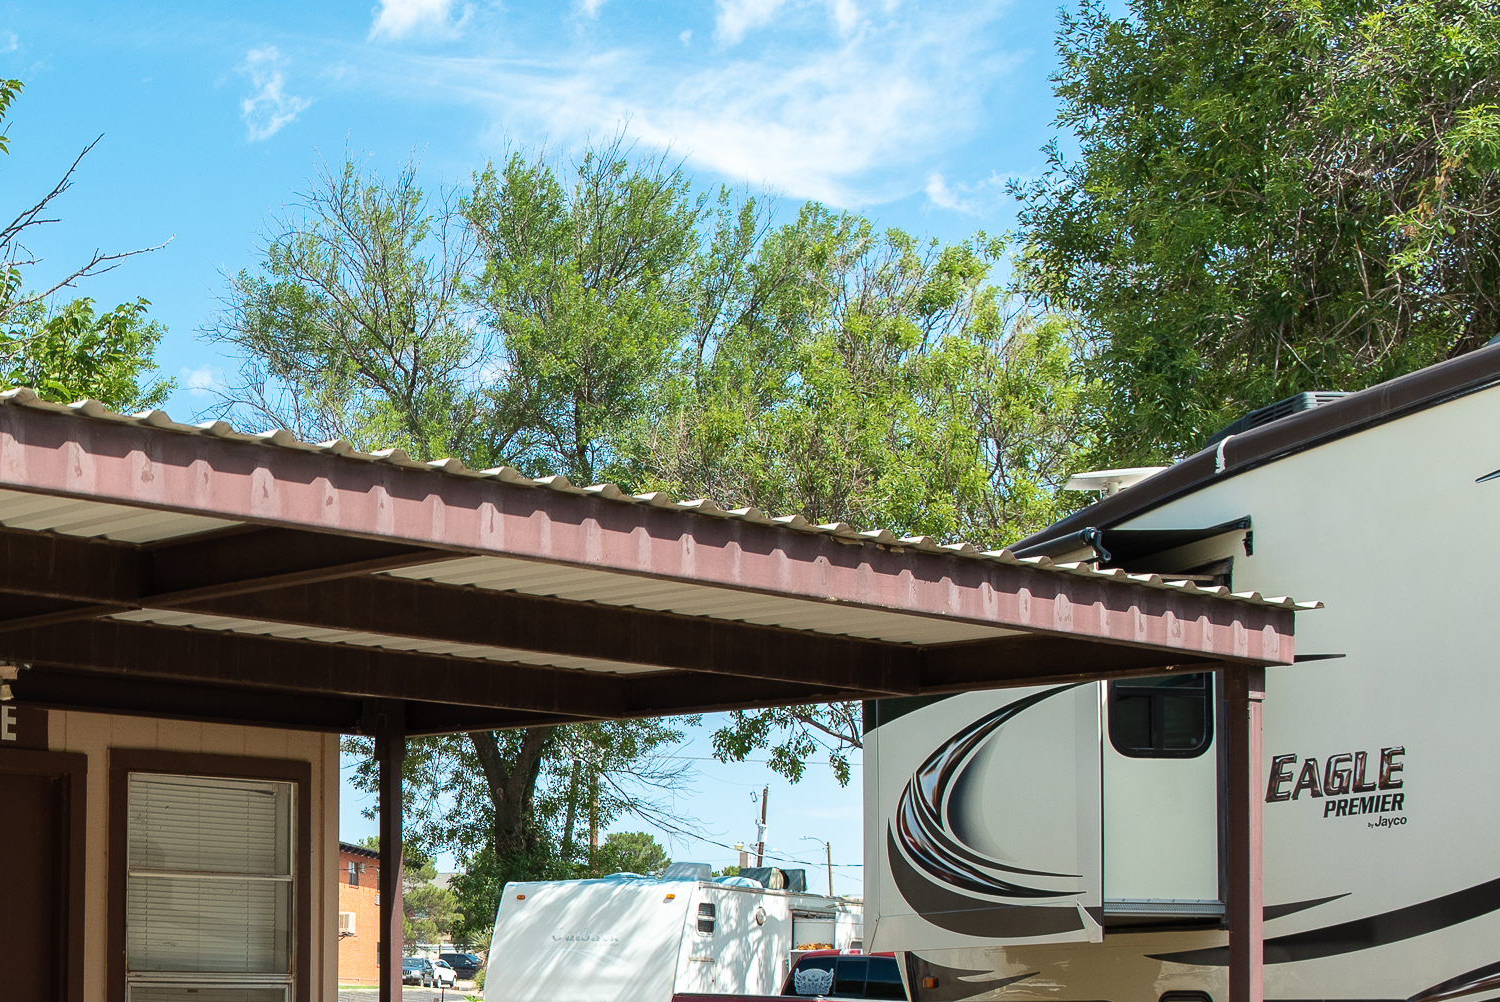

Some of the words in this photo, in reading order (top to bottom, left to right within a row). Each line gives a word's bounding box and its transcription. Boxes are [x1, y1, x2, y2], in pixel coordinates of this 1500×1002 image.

[1265, 746, 1405, 803] EAGLE
[1323, 793, 1405, 818] PREMIER
[1375, 815, 1408, 828] Jayco
